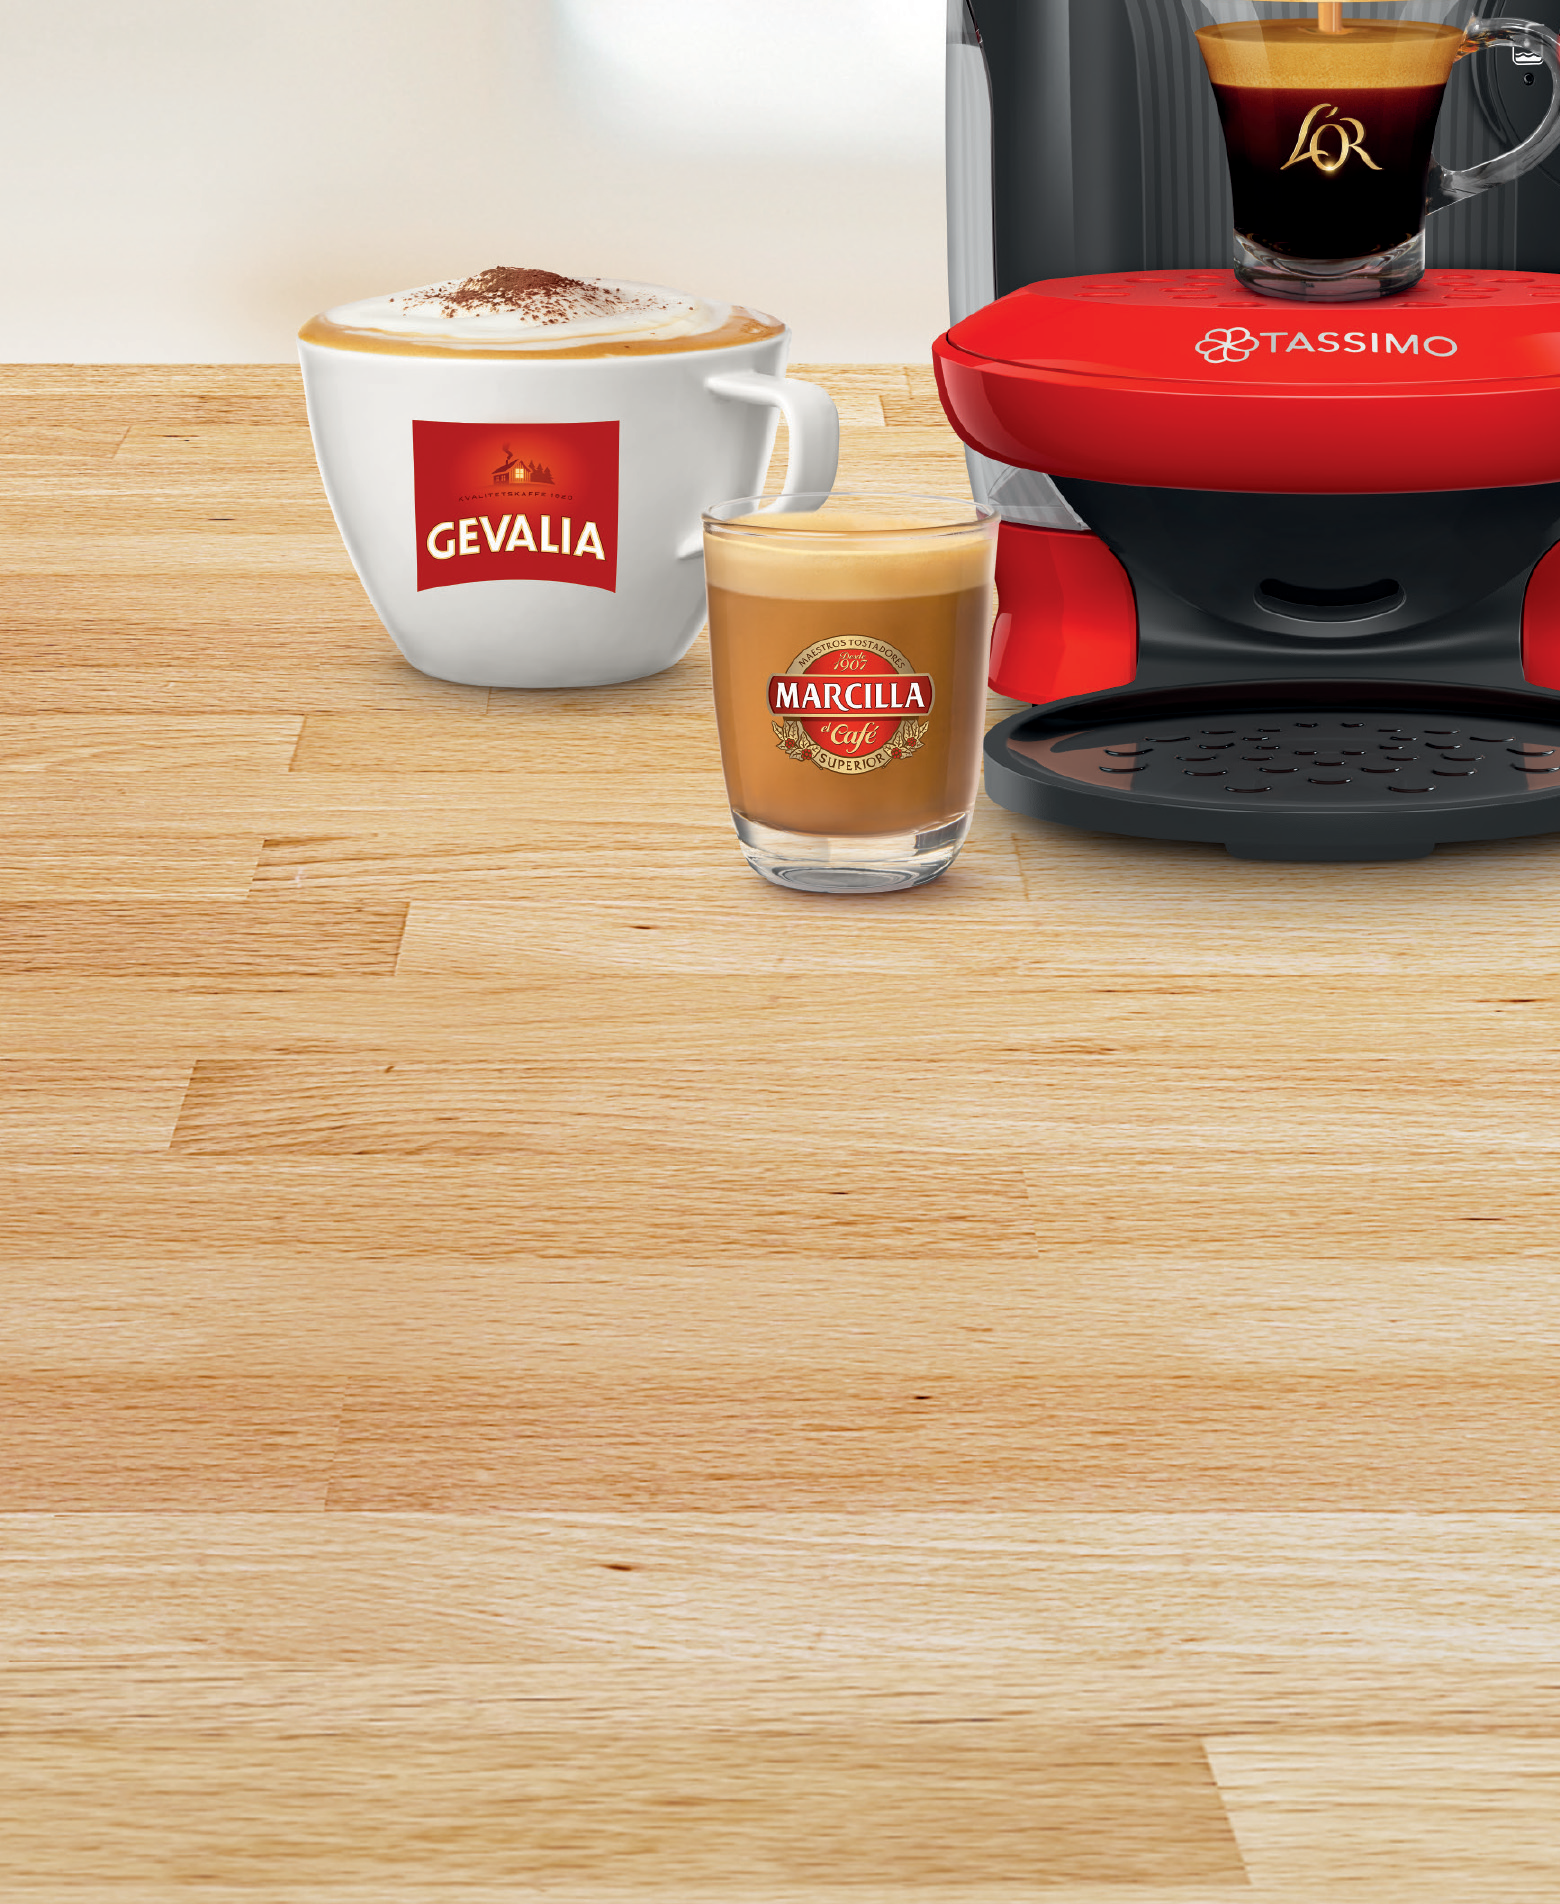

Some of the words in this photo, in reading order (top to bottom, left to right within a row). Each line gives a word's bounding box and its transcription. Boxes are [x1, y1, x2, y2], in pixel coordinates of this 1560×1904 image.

[1259, 331, 1458, 357] TASSIMO
[458, 491, 547, 502] KVALITETSKAFFE
[426, 514, 606, 560] GEVALIA
[798, 639, 847, 668] MAESTROS
[849, 639, 906, 669] TOSTADORES
[833, 659, 868, 672] 1907
[839, 651, 867, 660] Desde
[775, 682, 926, 712] MARCILLA
[820, 722, 832, 734] el
[830, 722, 880, 754] Café
[818, 753, 886, 771] SUPERIOR
